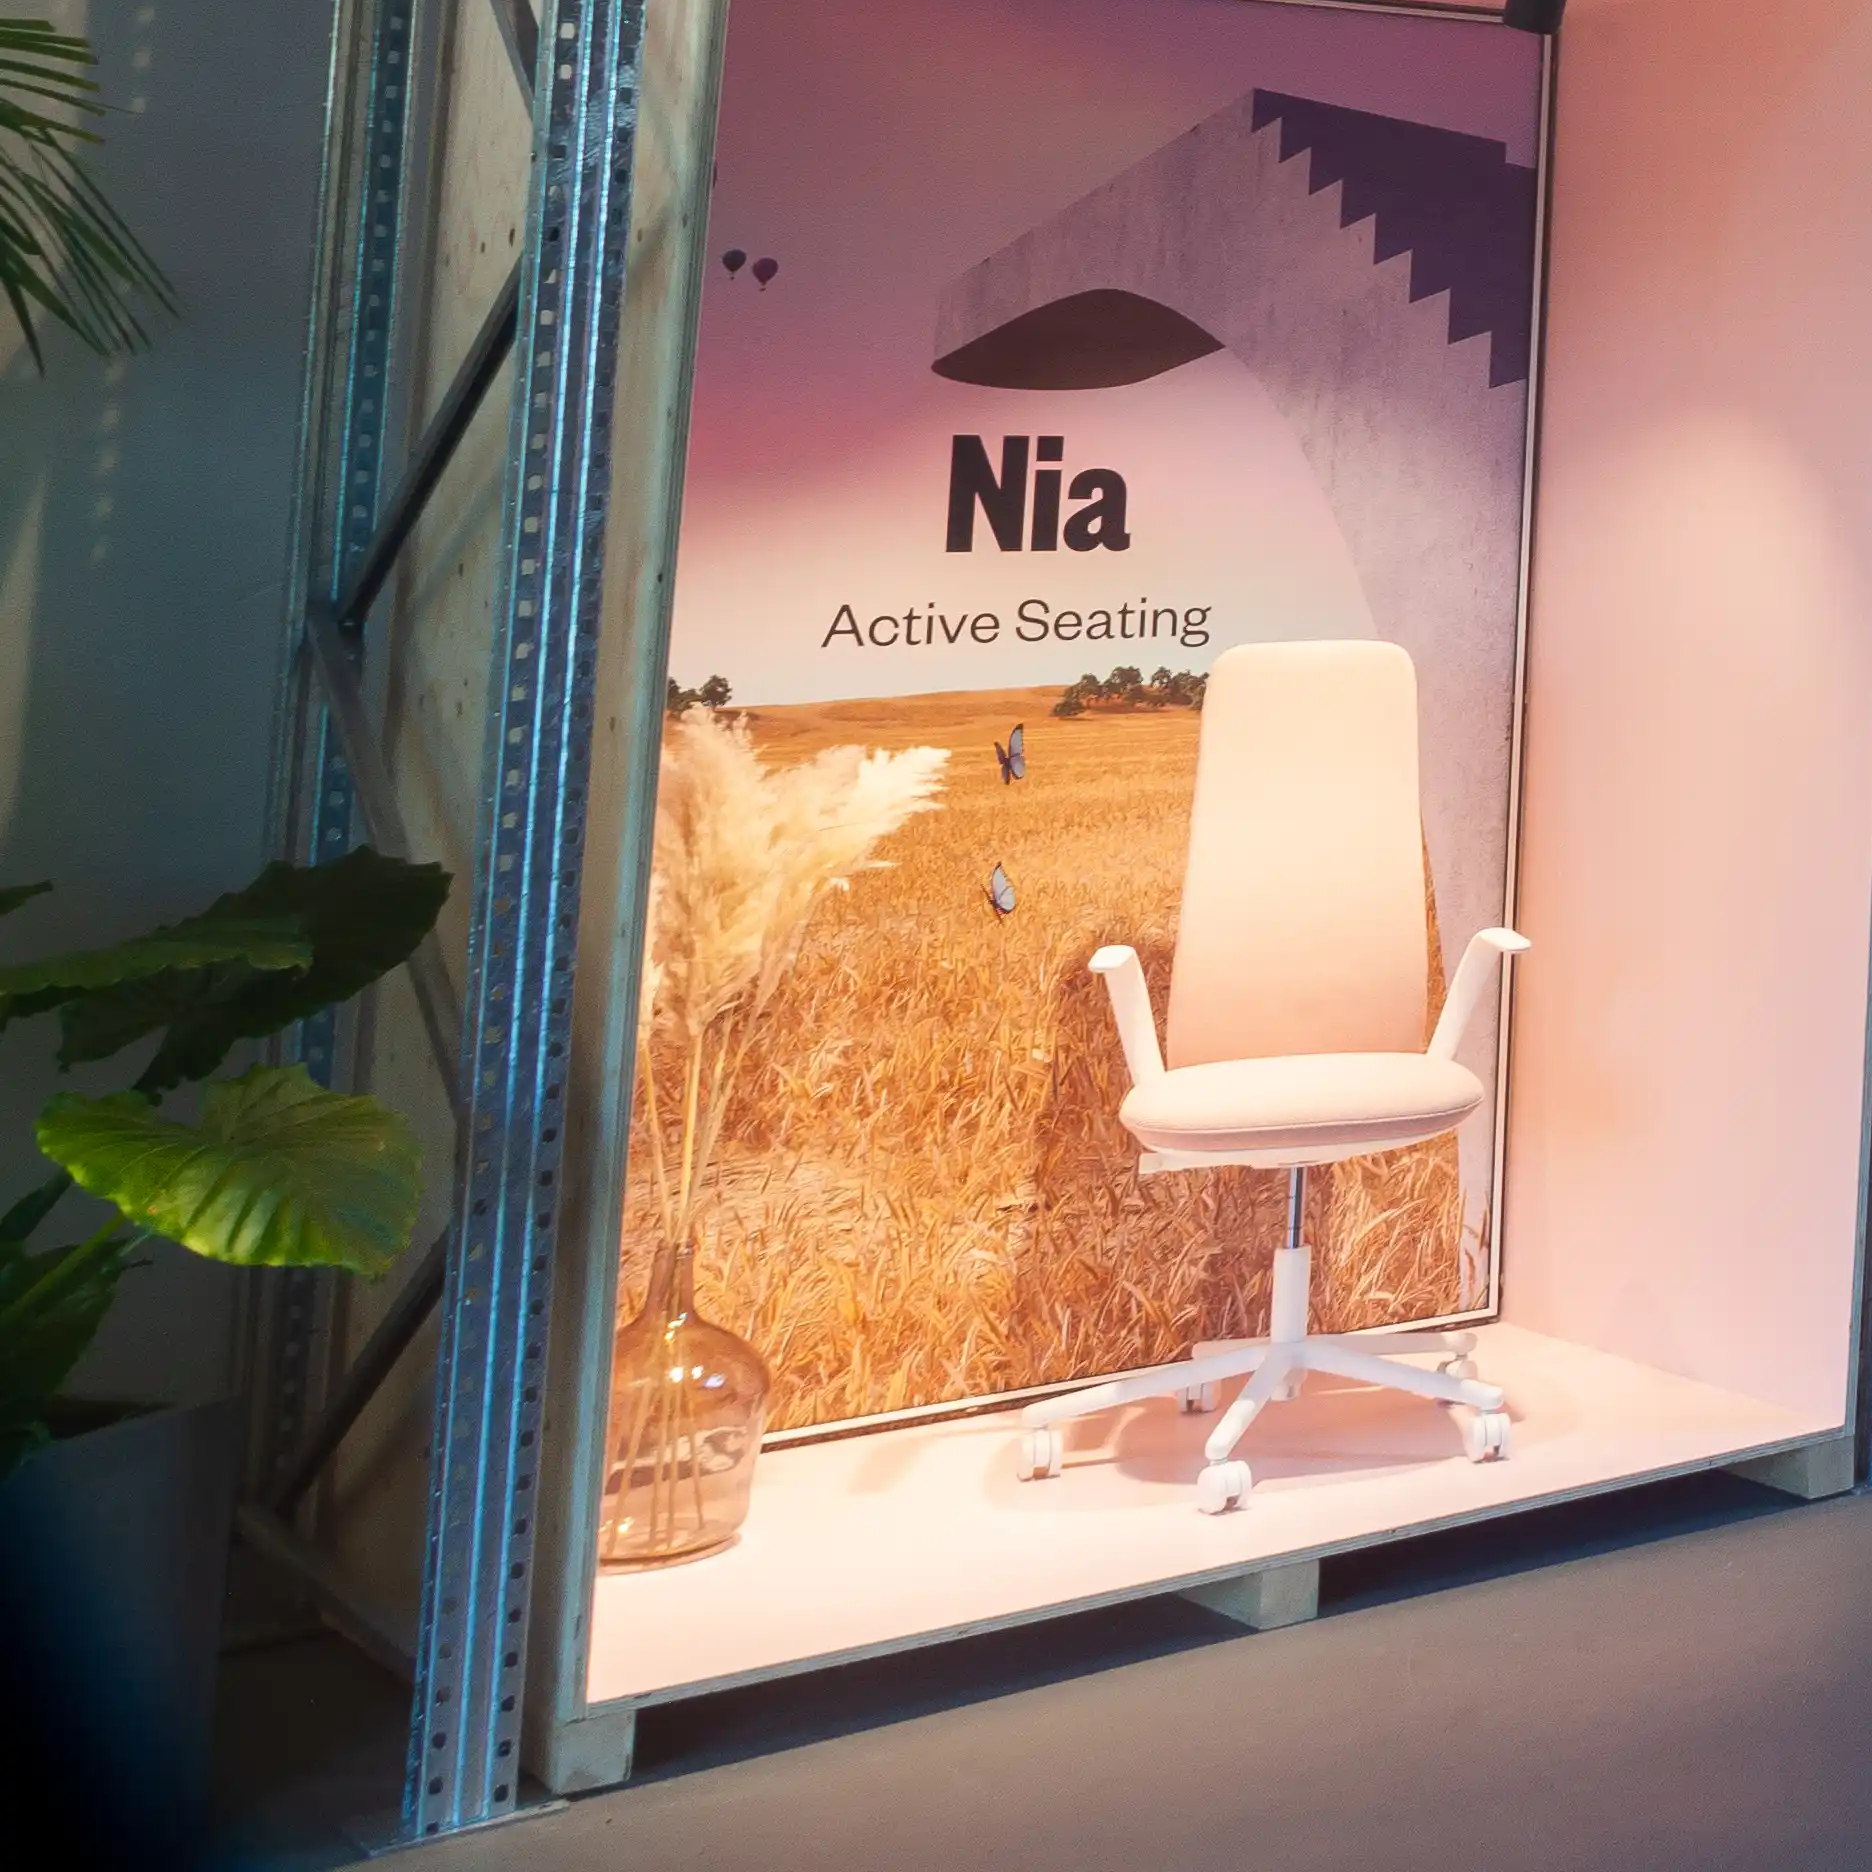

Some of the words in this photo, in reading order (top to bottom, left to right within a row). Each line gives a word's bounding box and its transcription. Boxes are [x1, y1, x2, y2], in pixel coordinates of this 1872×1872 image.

[945, 434, 1131, 553] Nia
[821, 601, 1000, 648] Active
[1015, 597, 1212, 647] Seating
